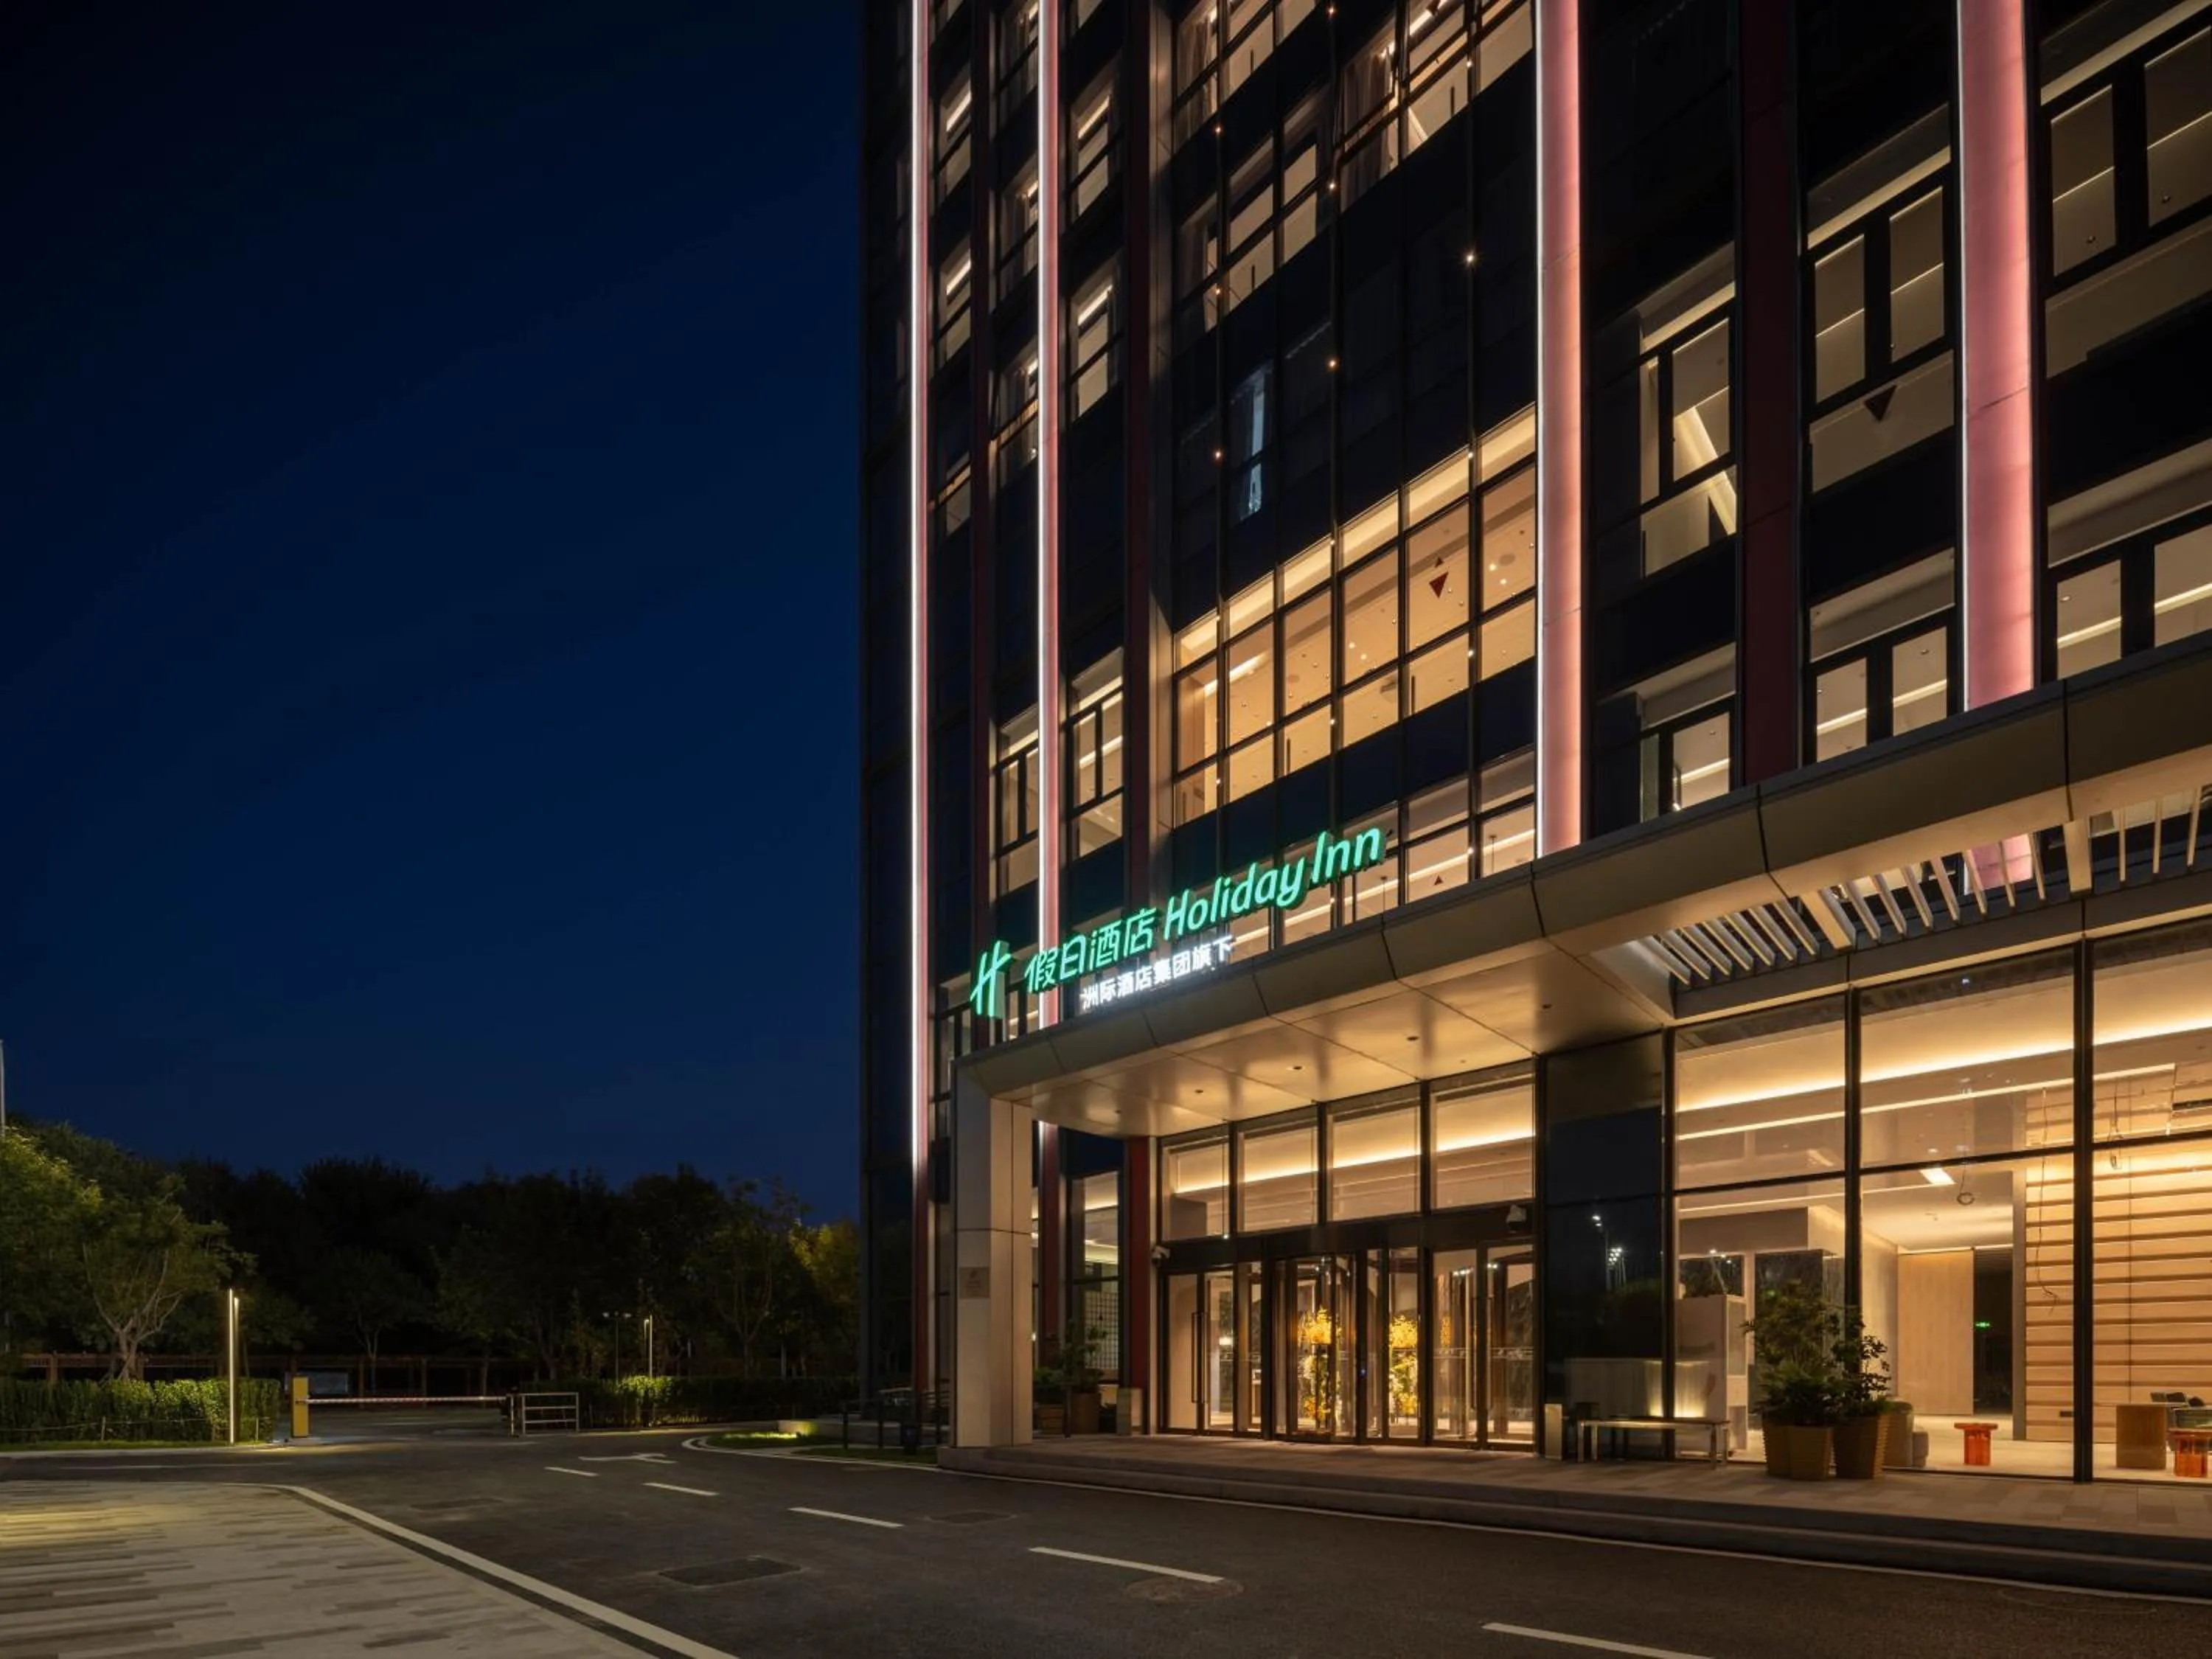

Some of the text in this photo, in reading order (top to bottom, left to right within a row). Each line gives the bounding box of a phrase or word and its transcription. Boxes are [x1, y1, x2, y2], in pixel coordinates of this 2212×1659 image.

[1163, 827, 1381, 942] Holiday Inn
[1023, 907, 1157, 993] 假日酒店
[1079, 934, 1234, 1010] 洲际酒店集团旗下
